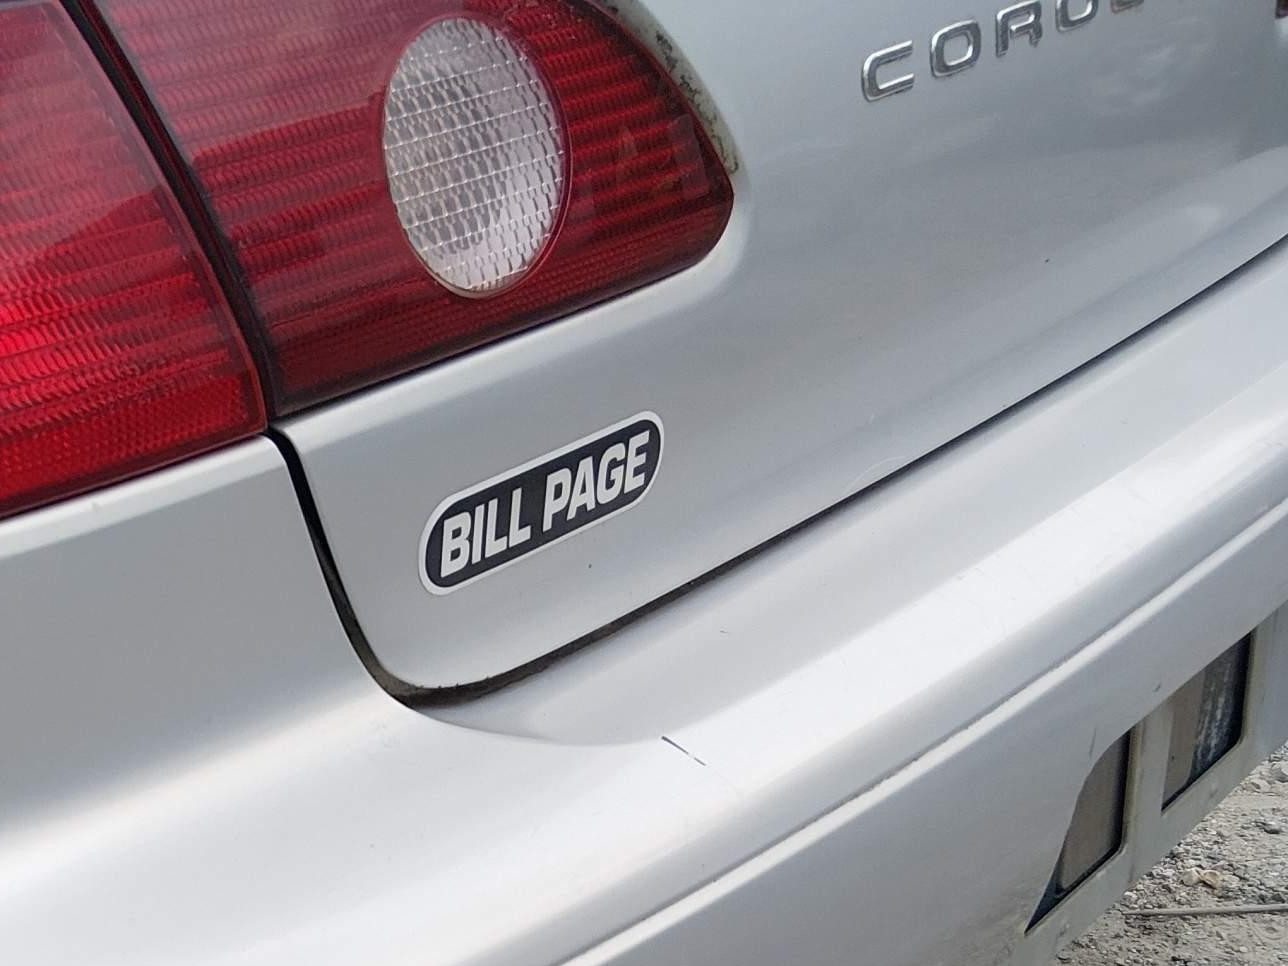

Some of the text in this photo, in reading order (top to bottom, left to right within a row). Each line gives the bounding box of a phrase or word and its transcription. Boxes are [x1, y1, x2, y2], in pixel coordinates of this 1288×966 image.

[862, 0, 1145, 102] CORO
[440, 429, 650, 578] BILL PAGE
